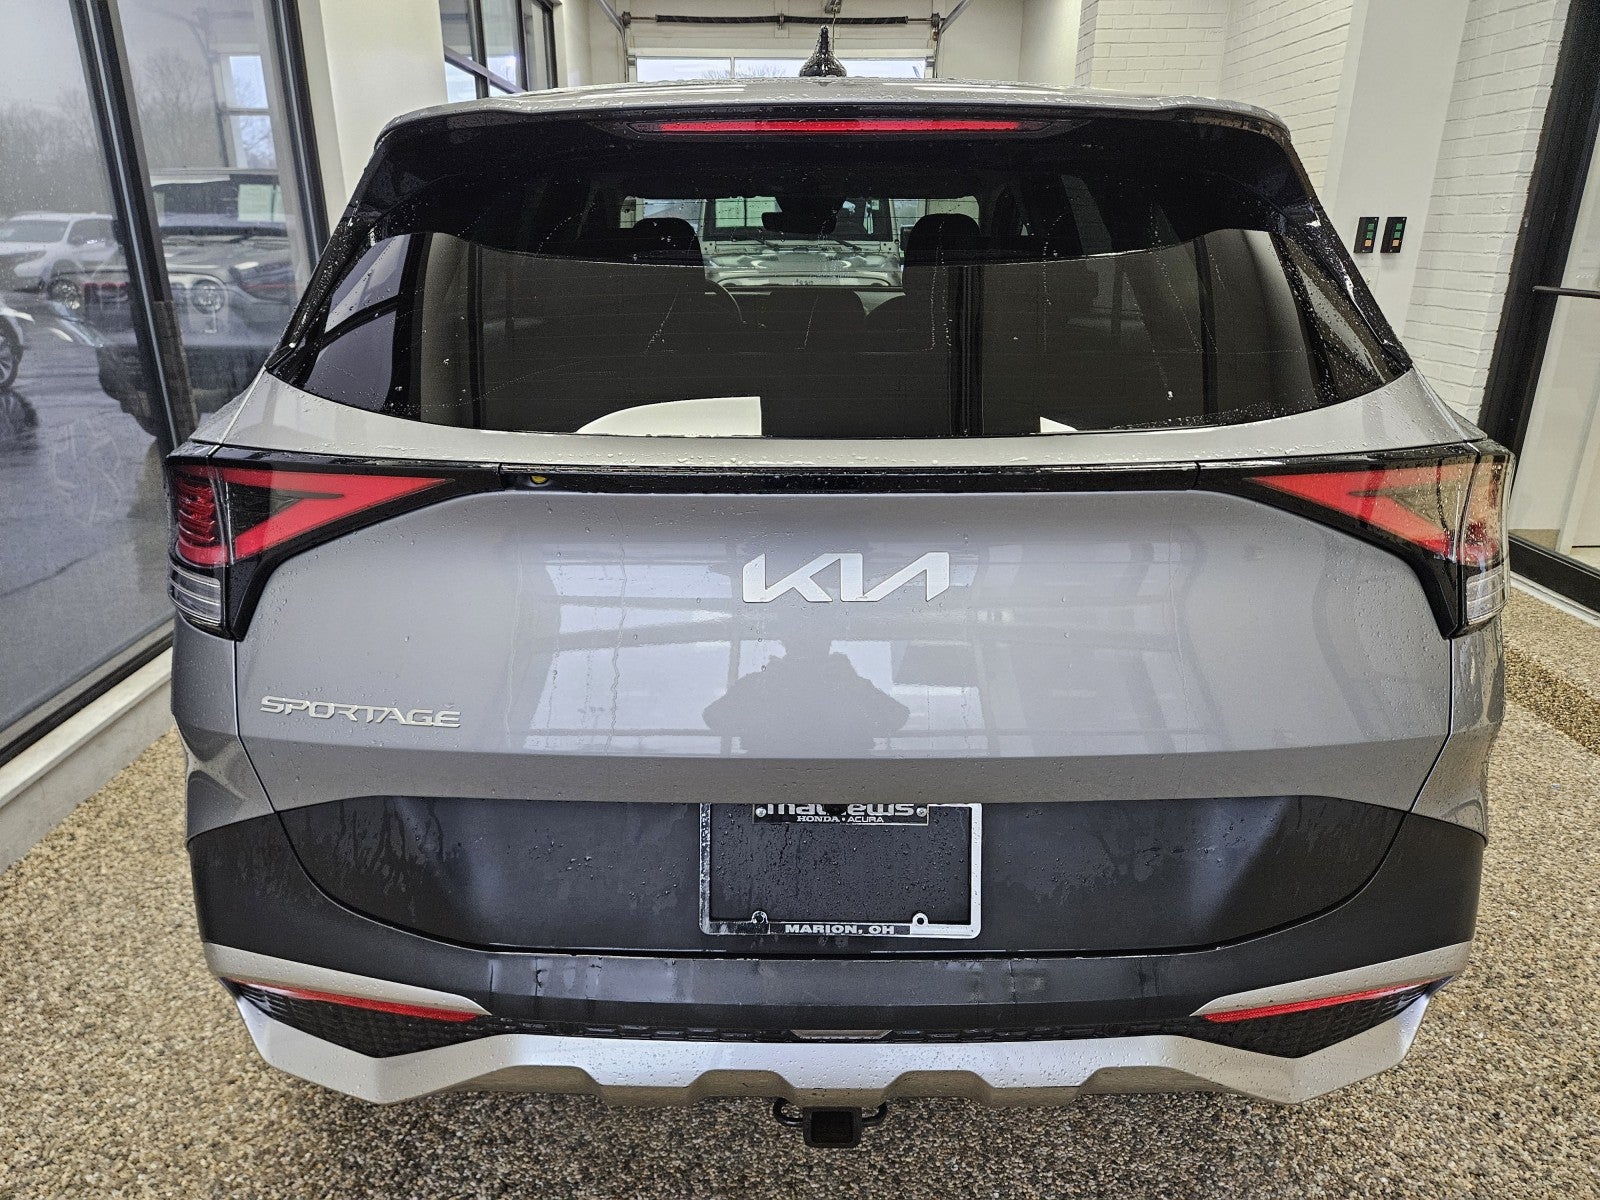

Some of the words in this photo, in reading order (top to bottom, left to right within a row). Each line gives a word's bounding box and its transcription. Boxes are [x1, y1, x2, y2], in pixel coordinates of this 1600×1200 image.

[742, 551, 950, 604] KIA
[259, 695, 462, 729] SPORTAGE
[767, 804, 915, 817] matews
[796, 815, 841, 823] HONDA
[784, 924, 863, 935] MARION,
[868, 925, 895, 935] OH
